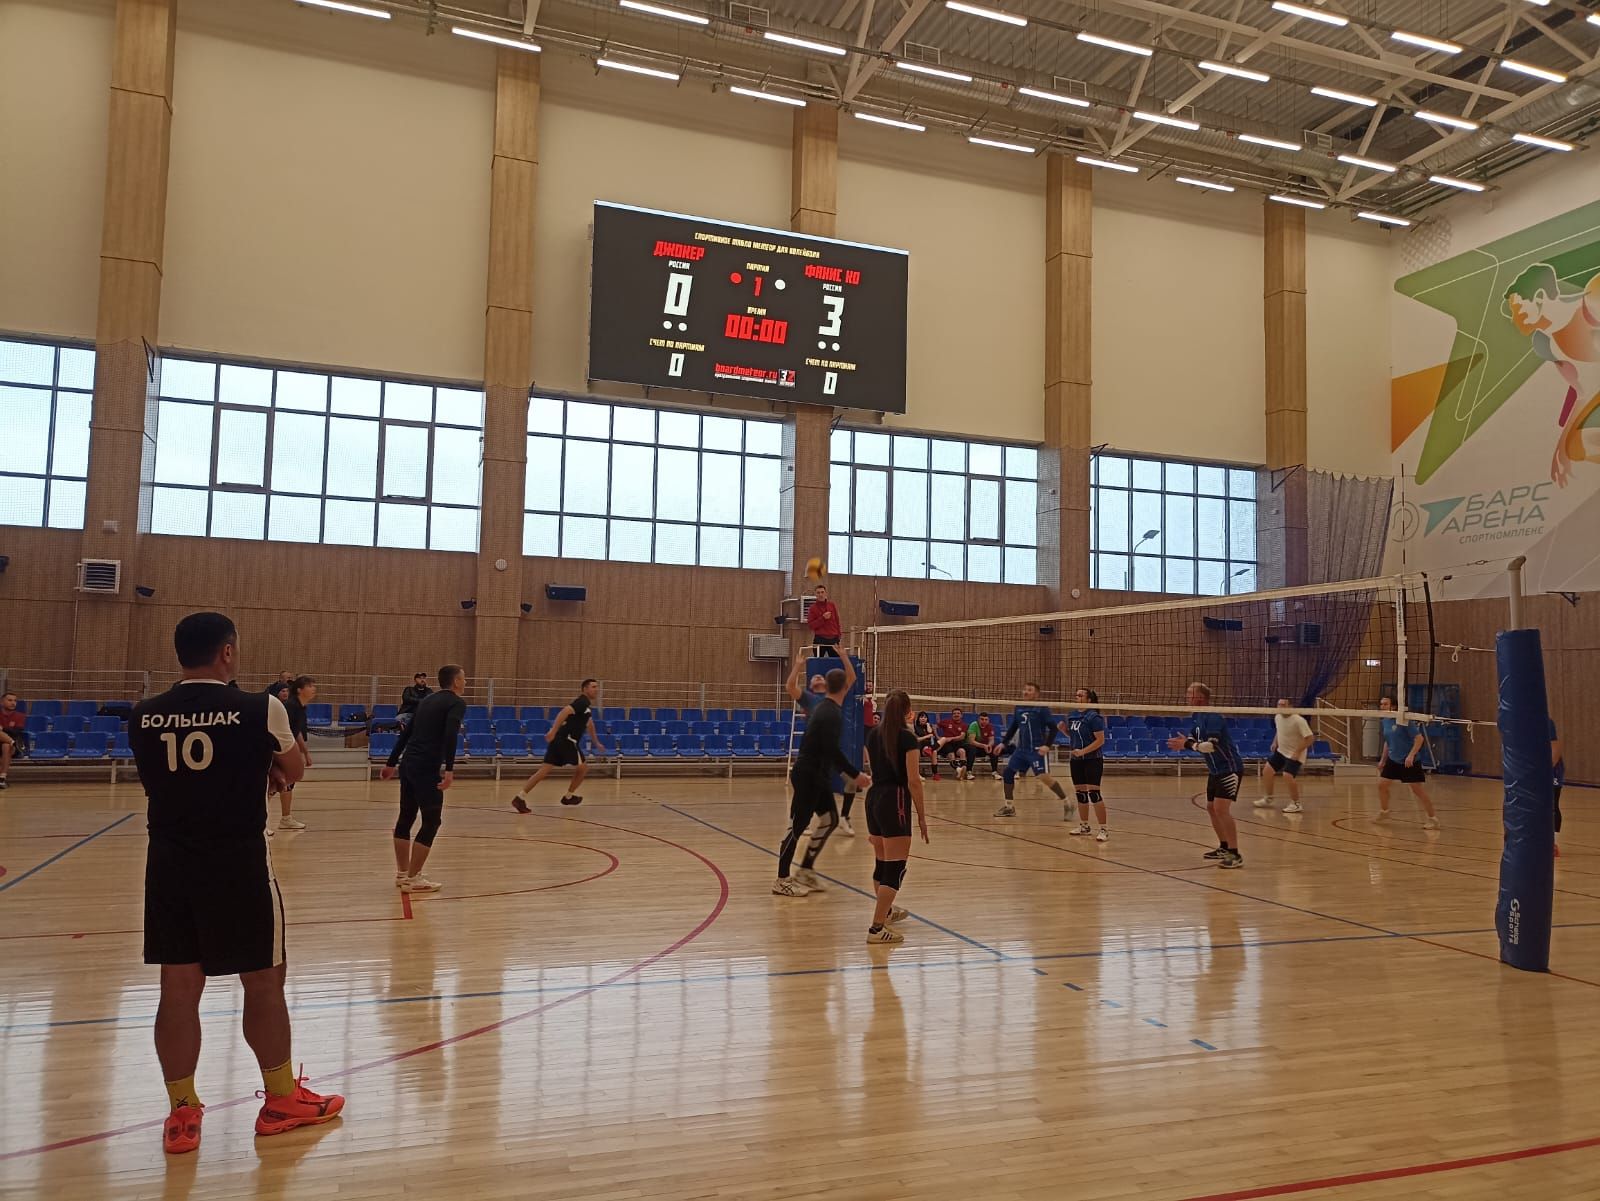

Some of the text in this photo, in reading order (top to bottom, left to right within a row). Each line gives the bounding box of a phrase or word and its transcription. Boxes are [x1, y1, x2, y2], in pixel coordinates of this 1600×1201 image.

[653, 240, 705, 260] ДЖОКЕР
[776, 245, 788, 254] ДЛЯ
[668, 260, 690, 270] РОССИЯ
[746, 262, 770, 273] ПАРТИЯ
[664, 273, 693, 316] 0
[753, 276, 764, 297] 1
[822, 283, 842, 292] РОССИЯ
[747, 306, 767, 316] ВРЕМЯ
[818, 295, 845, 337] 3
[725, 314, 788, 344] 00:00
[666, 340, 675, 348] ПО
[668, 352, 685, 377] 0
[715, 363, 778, 380] boardmeteor.ru
[820, 359, 829, 368] ПО
[823, 371, 838, 395] 0
[1466, 482, 1553, 513] БАРС
[1441, 504, 1545, 535] АРЕНА
[1459, 526, 1544, 545] СПОРТКОМПЛЕКС
[141, 711, 241, 729] БОЛЬШАК
[1070, 720, 1082, 731] 10
[160, 731, 214, 772] 10
